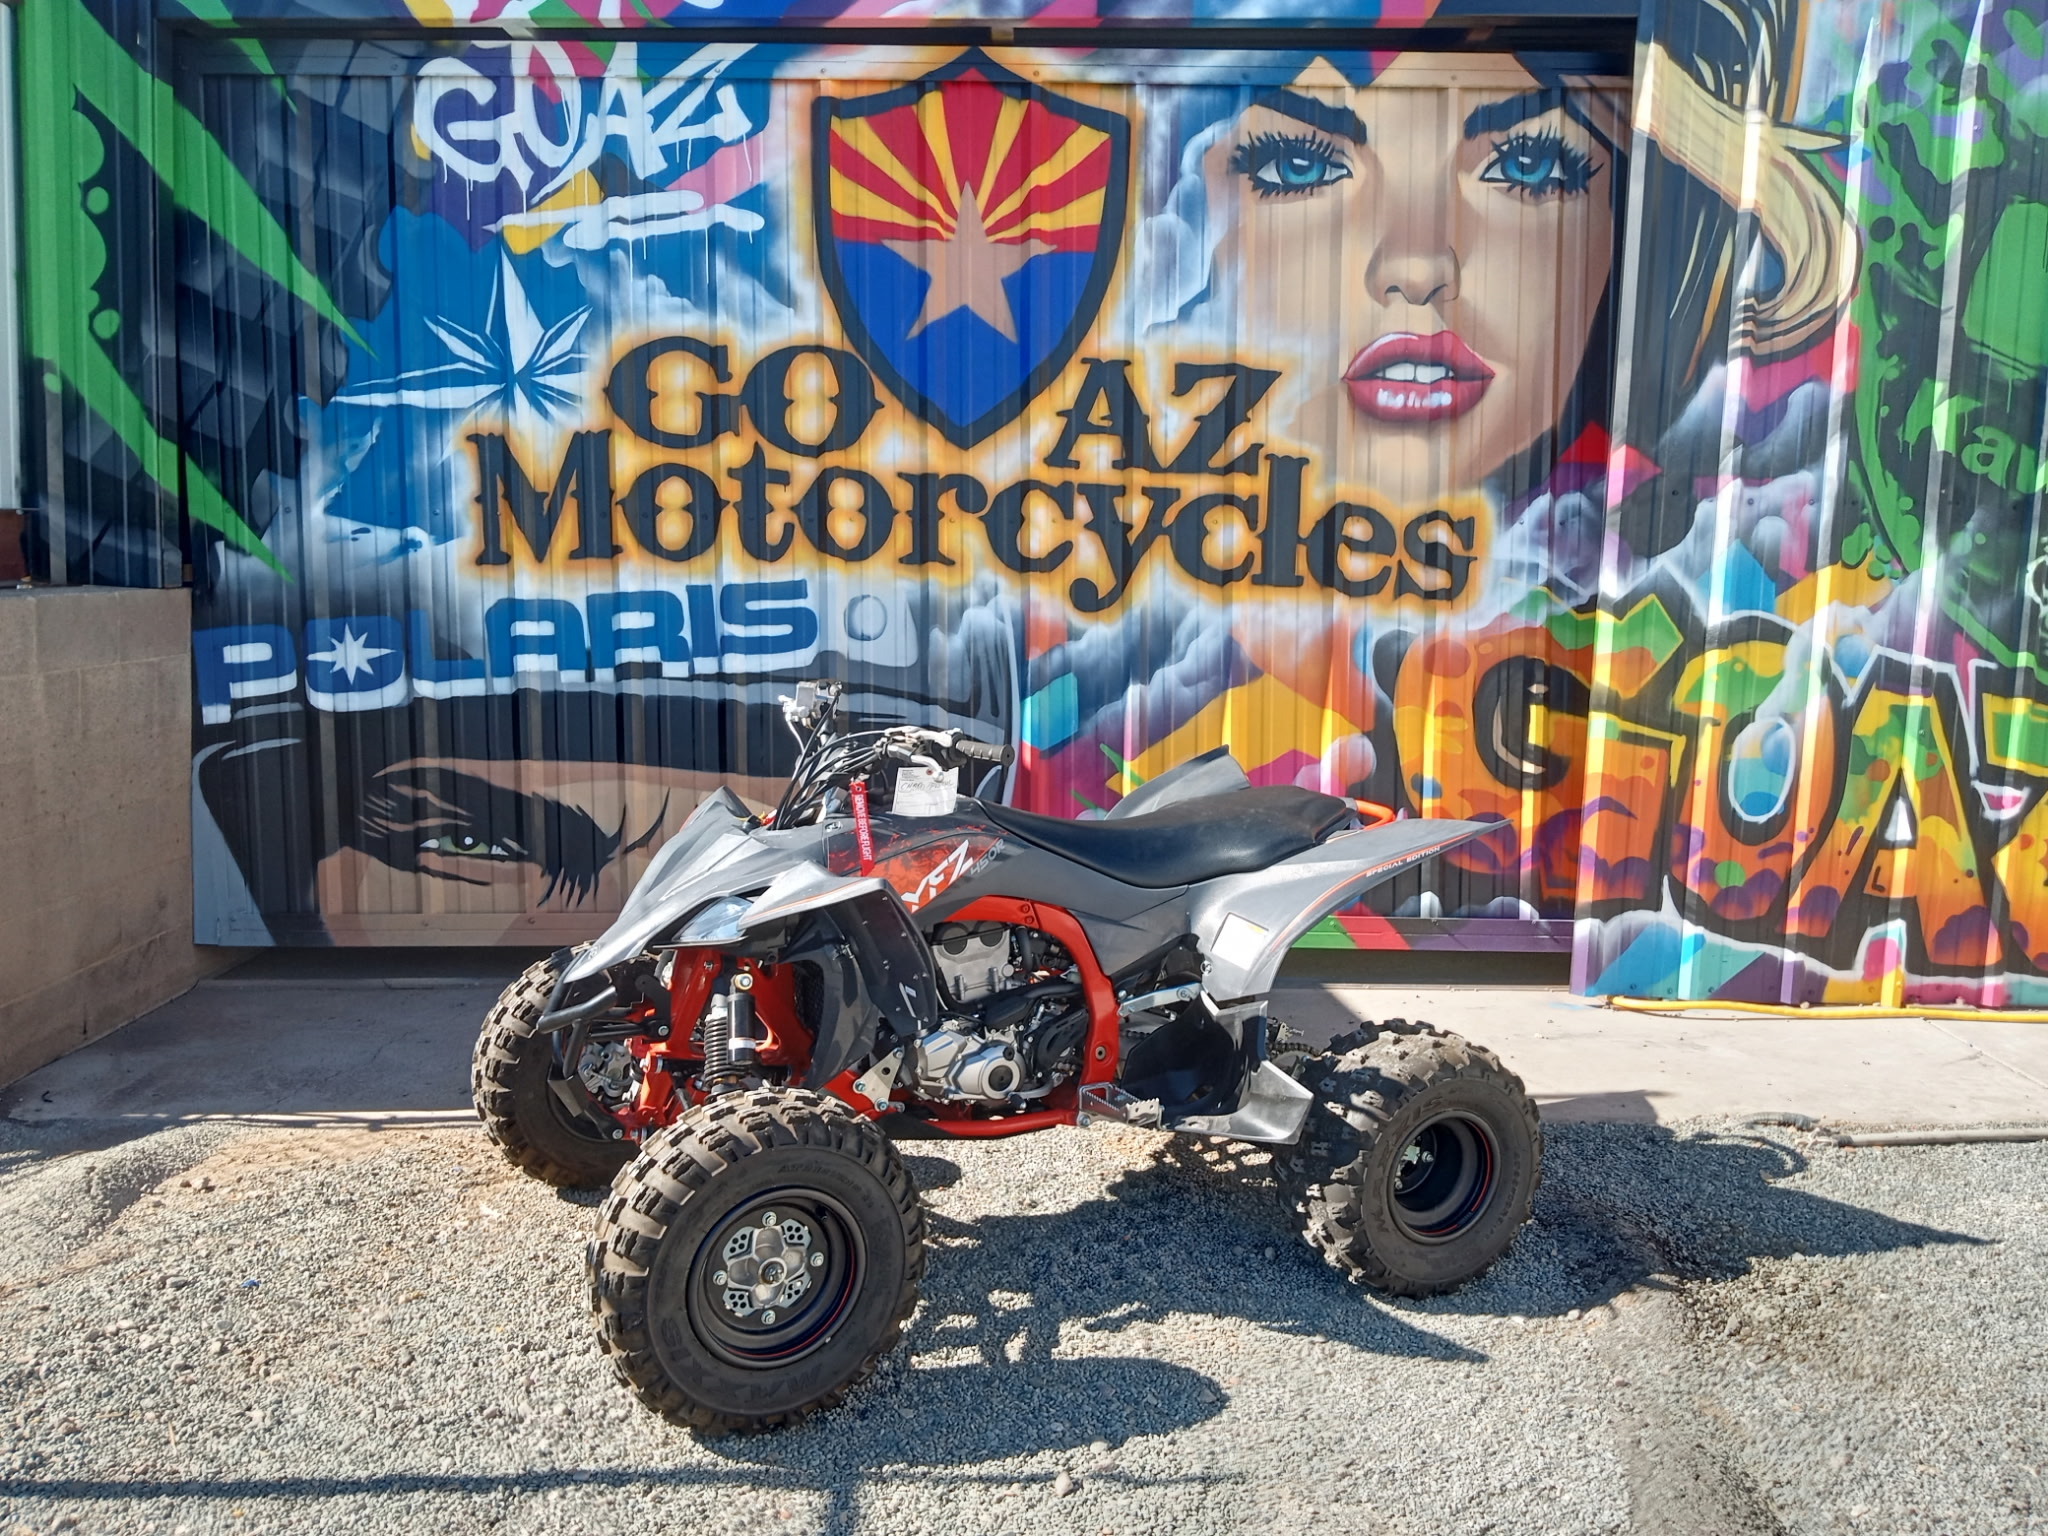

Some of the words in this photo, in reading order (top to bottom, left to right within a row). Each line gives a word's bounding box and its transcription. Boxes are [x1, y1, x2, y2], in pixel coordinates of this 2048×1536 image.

[603, 336, 886, 458] GO
[1043, 356, 1283, 476] AZ
[465, 428, 1479, 613] Motorcycles
[193, 579, 819, 726] POLARIS
[854, 794, 867, 818] REMOVE
[858, 818, 870, 843] BEFORE
[861, 840, 873, 861] FLIGHT
[900, 839, 974, 914] YFZ
[970, 838, 1005, 876] 450R
[1365, 861, 1404, 878] SPECIAL
[1406, 846, 1441, 863] EDITION
